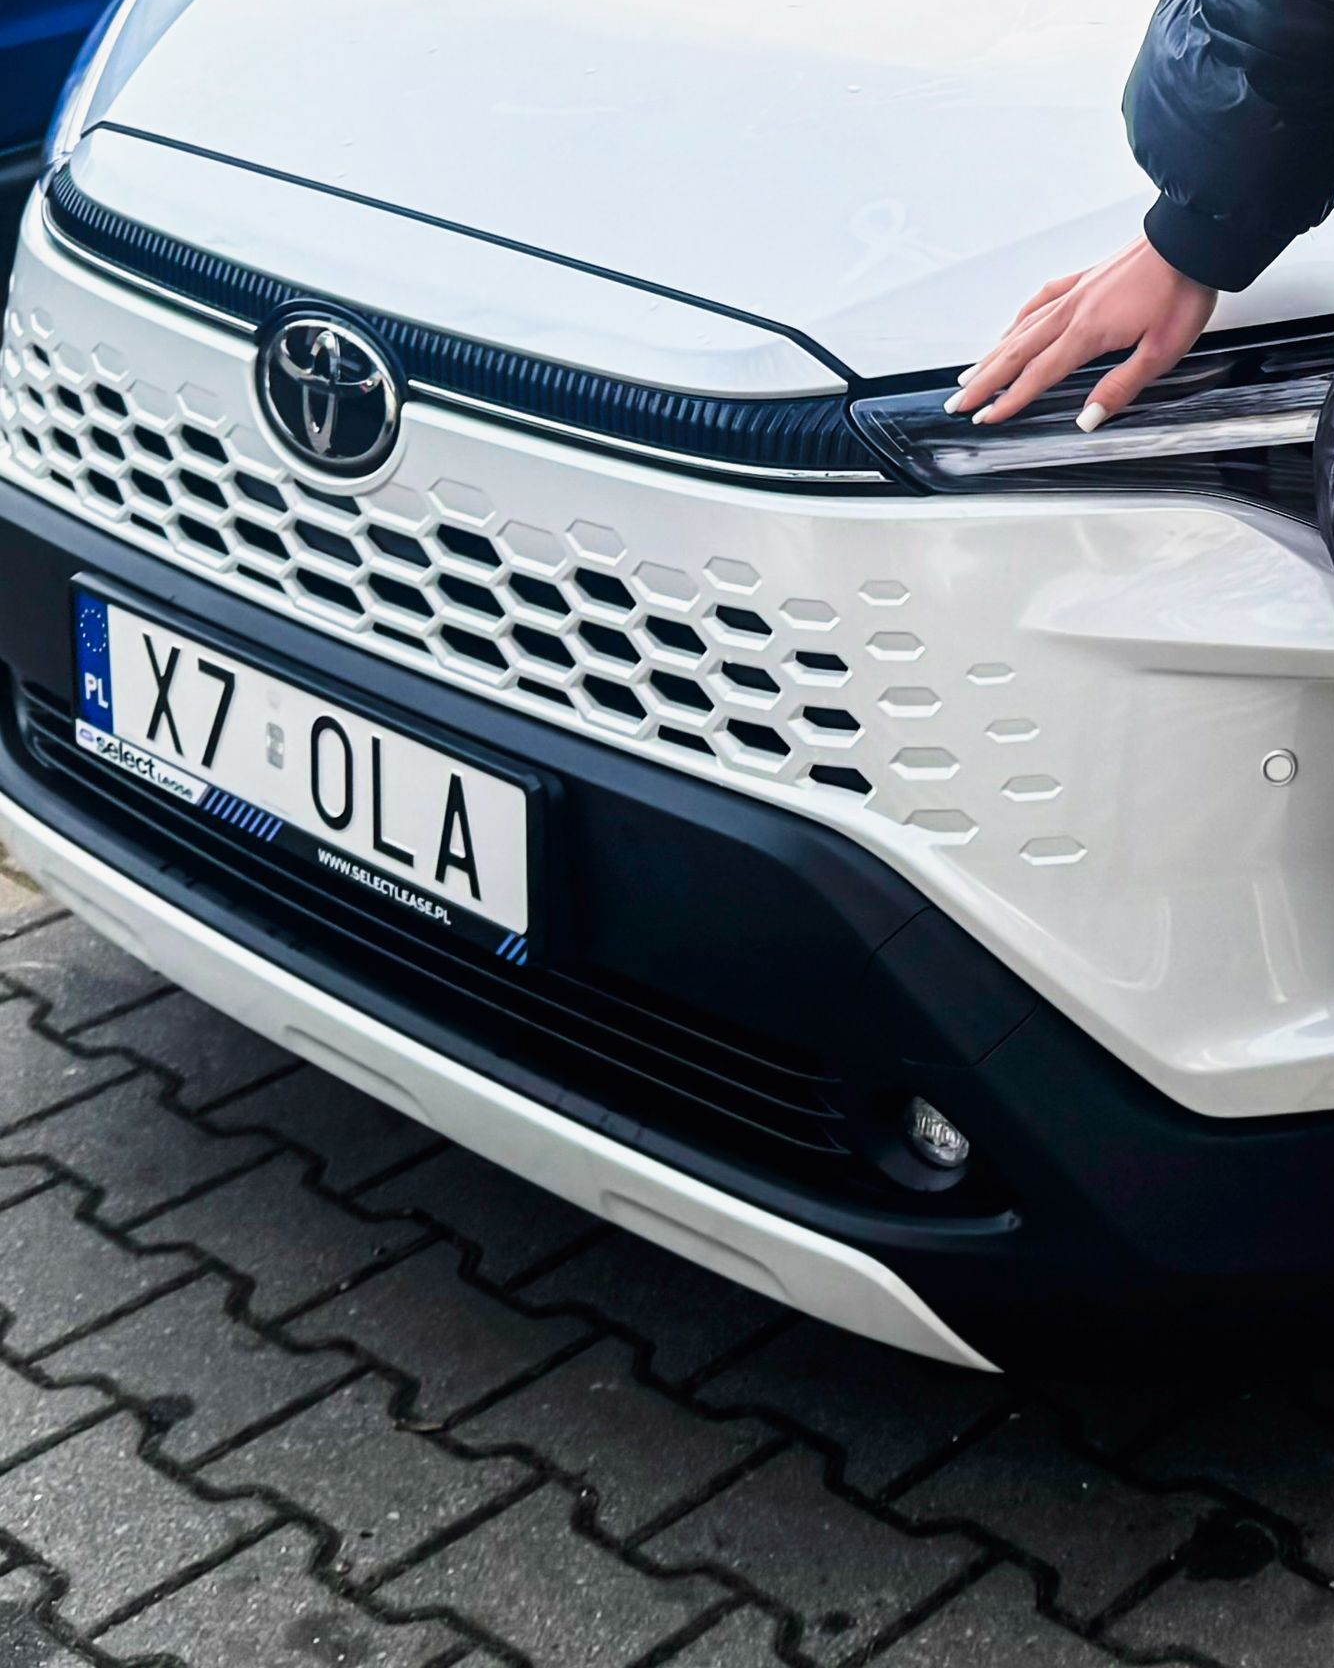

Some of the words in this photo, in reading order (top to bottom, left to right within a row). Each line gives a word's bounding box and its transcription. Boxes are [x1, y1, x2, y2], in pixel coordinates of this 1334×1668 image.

[84, 671, 109, 709] PL
[96, 736, 156, 780] select
[142, 632, 235, 768] X7
[310, 714, 482, 902] OLA
[317, 847, 452, 926] WWW.SELECTLEASE.PL
